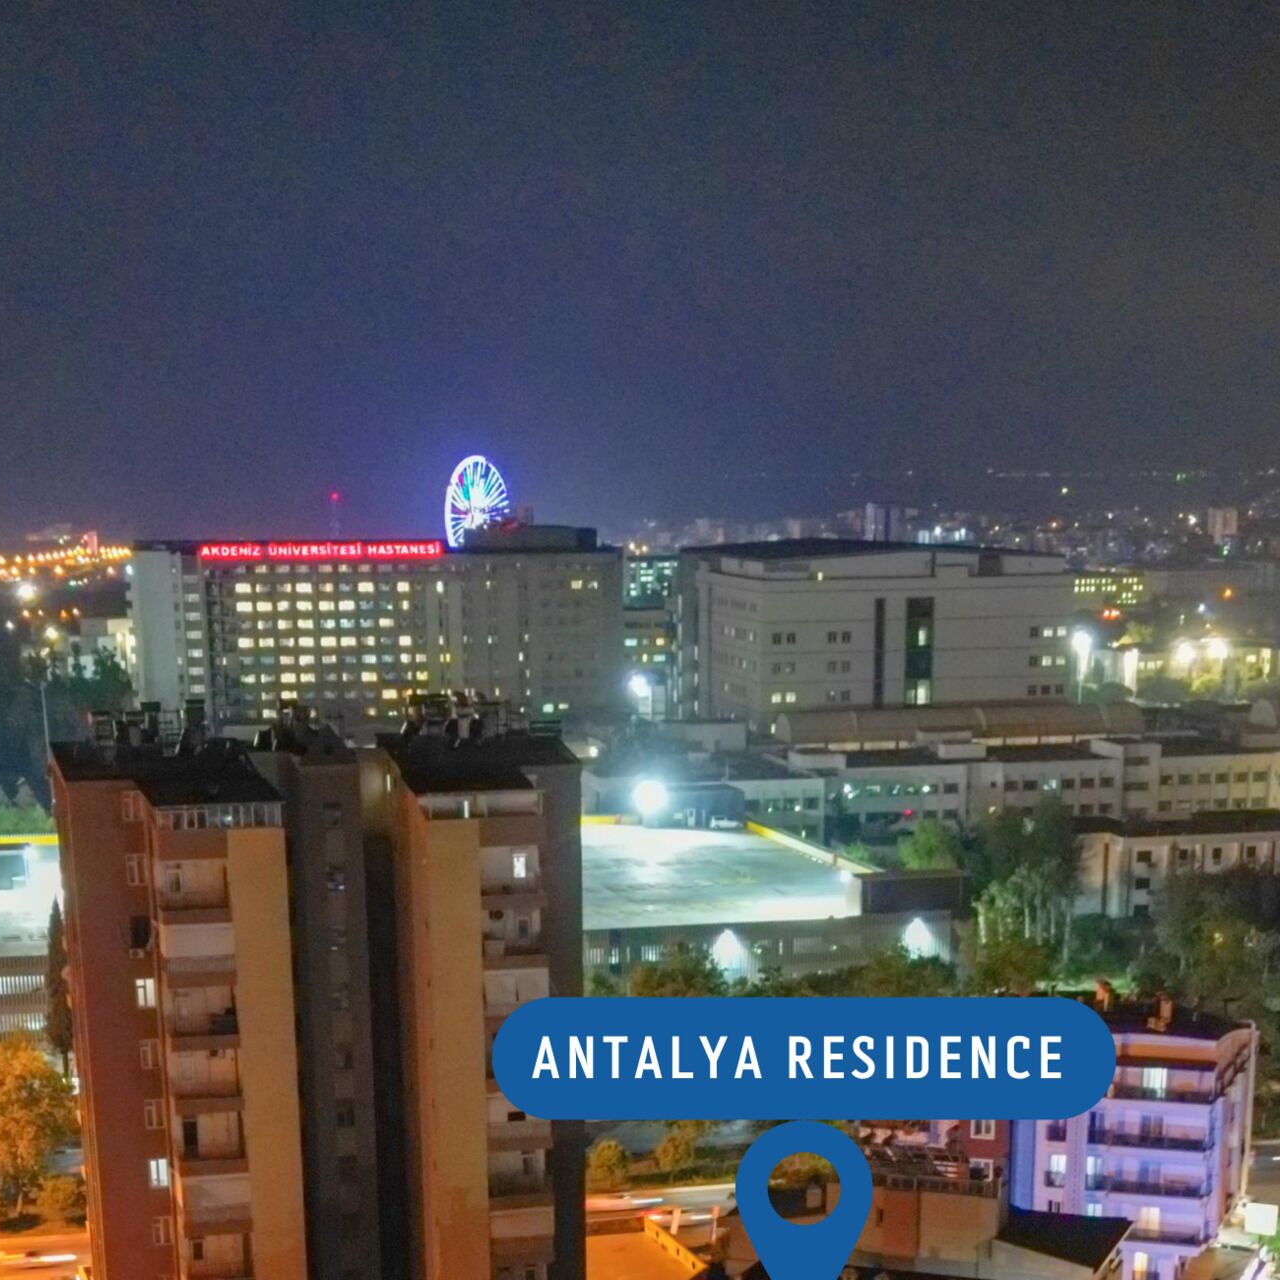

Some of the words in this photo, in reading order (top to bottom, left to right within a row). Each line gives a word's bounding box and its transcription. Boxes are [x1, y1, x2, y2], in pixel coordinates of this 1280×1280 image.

[201, 543, 260, 556] AKDENİZ
[268, 542, 362, 556] ÜNİVERSİTESİ
[368, 541, 440, 555] HASTANESİ
